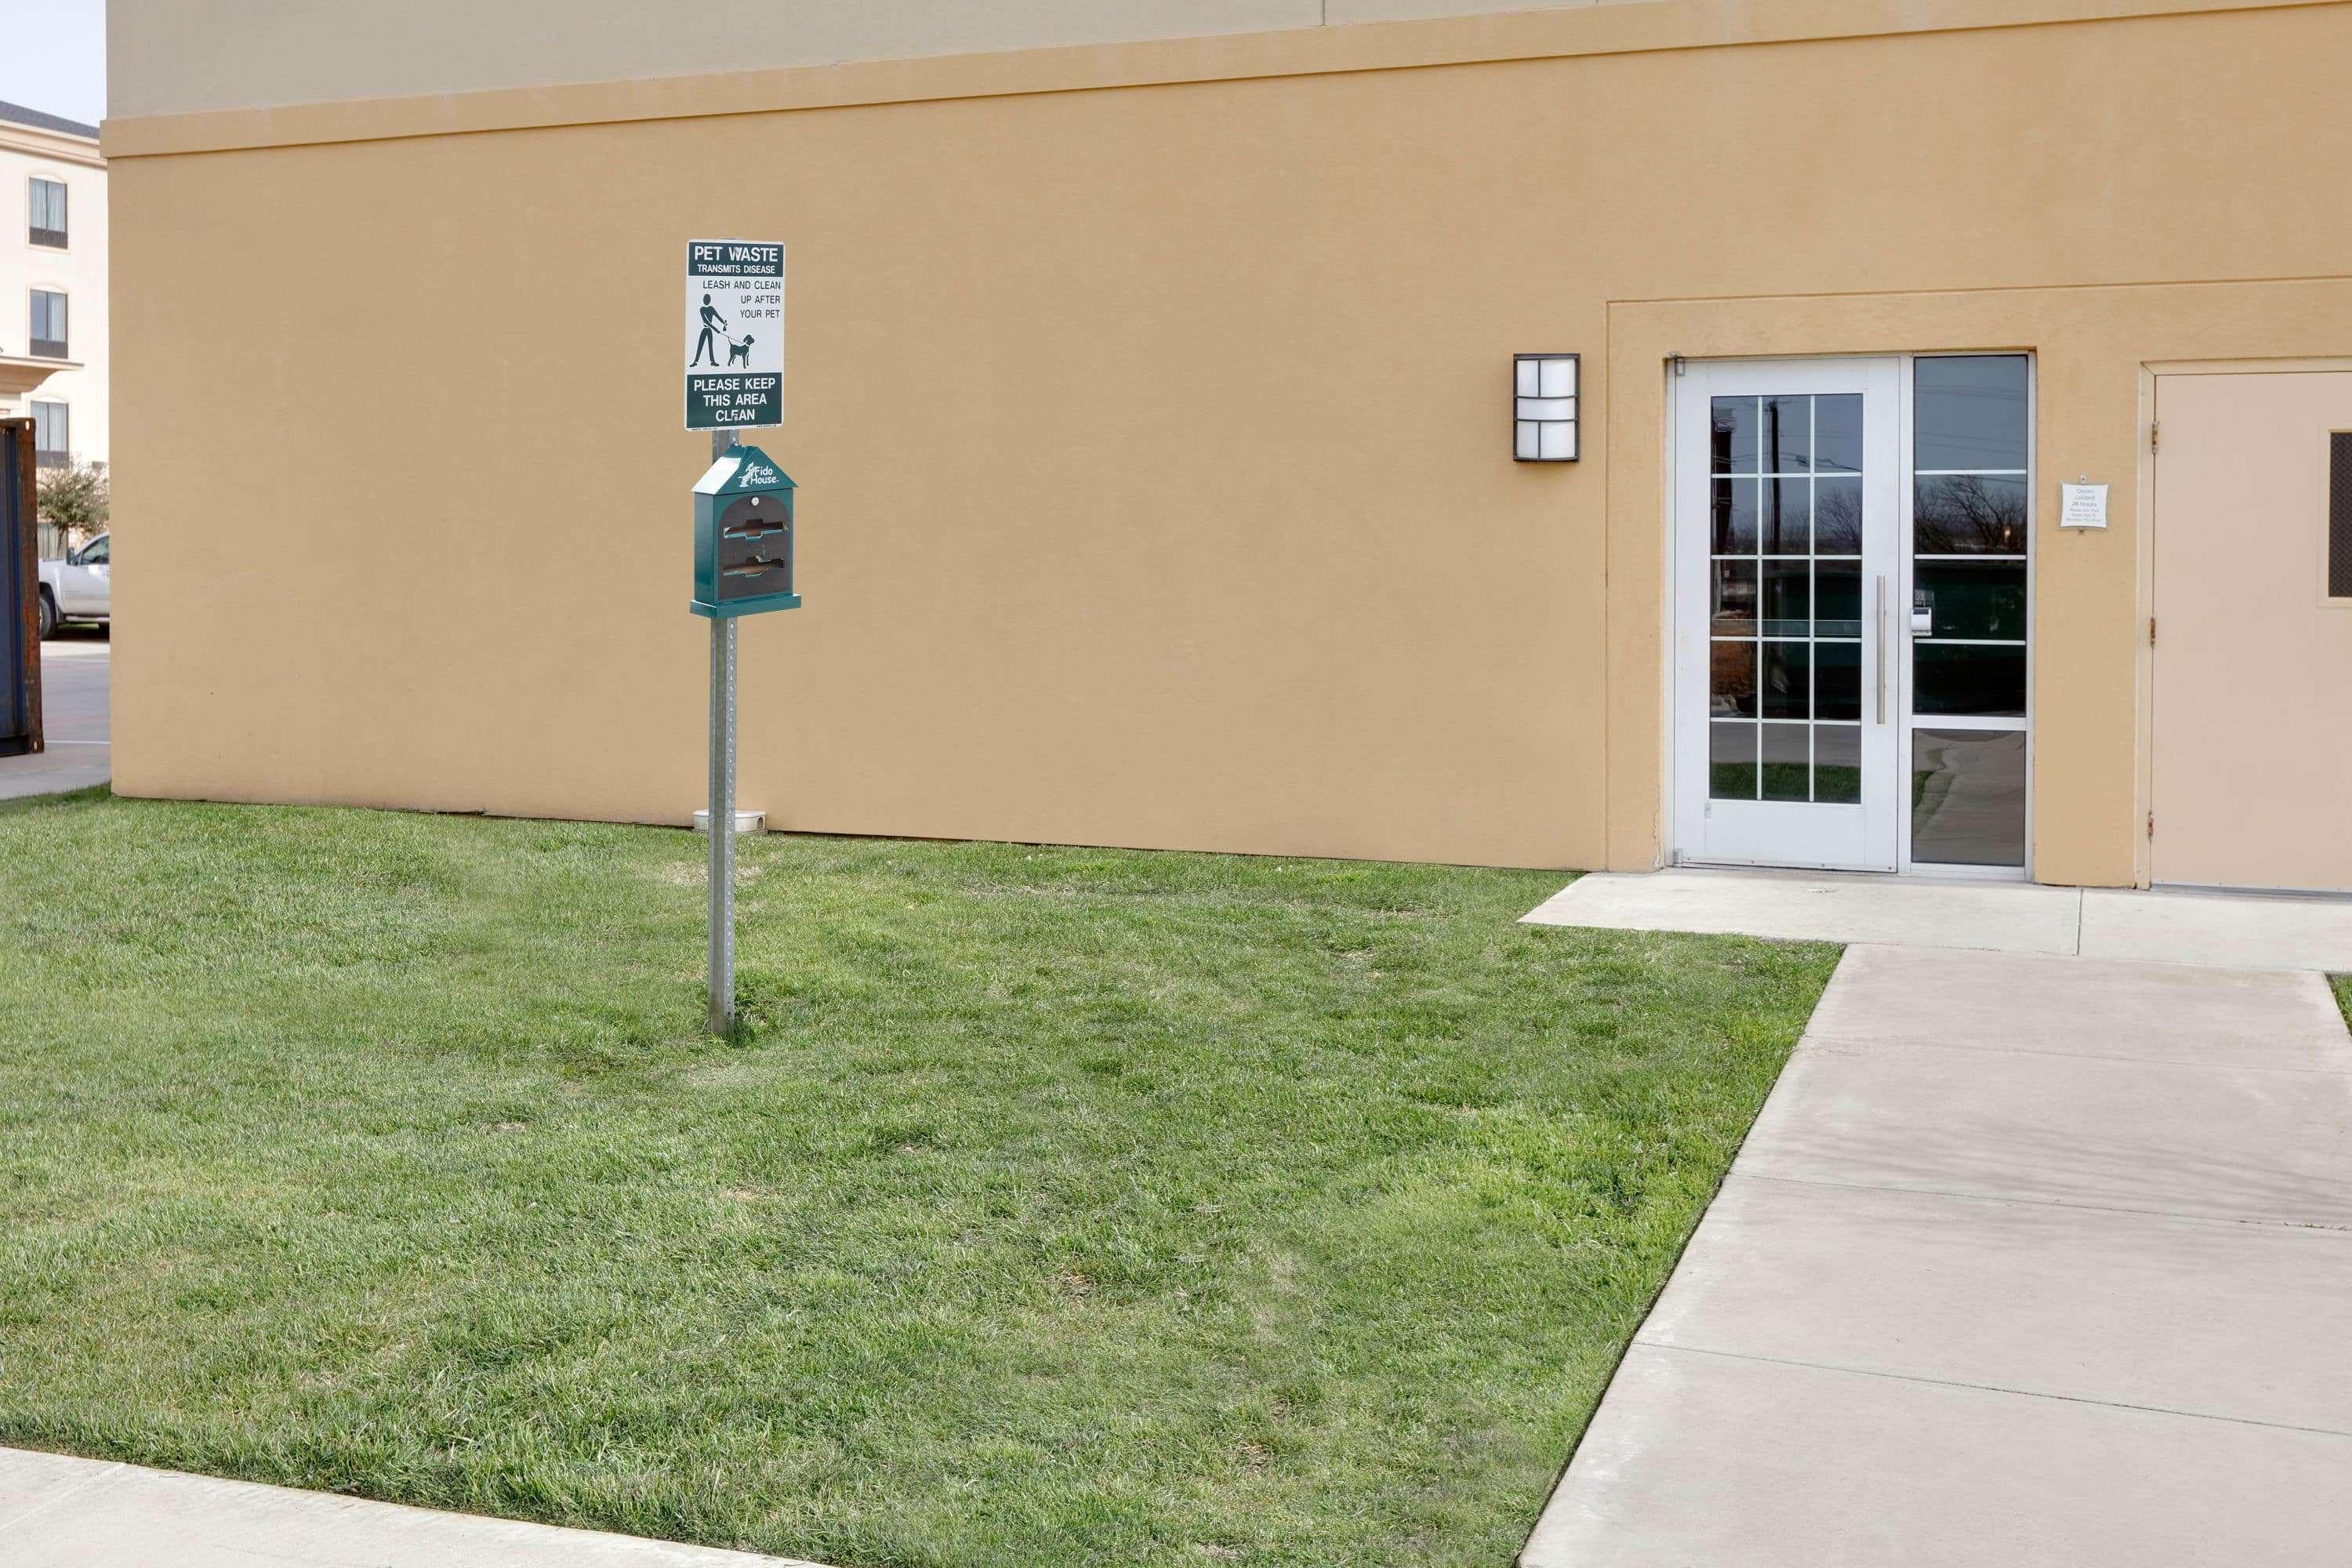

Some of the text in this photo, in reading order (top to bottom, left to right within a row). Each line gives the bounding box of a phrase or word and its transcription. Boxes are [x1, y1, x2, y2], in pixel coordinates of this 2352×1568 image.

[695, 245, 779, 263] PET WASTE
[697, 263, 776, 274] TRANSMITS DISEASE
[702, 280, 781, 290] LEASH AND CLEAN
[741, 295, 781, 304] UP AFTER
[740, 309, 781, 318] YOUR PET
[694, 377, 776, 391] PLEASE KEEP
[703, 393, 768, 407] THIS AREA
[715, 408, 755, 422] CLEAN
[754, 465, 773, 476] Fido
[750, 475, 777, 485] House
